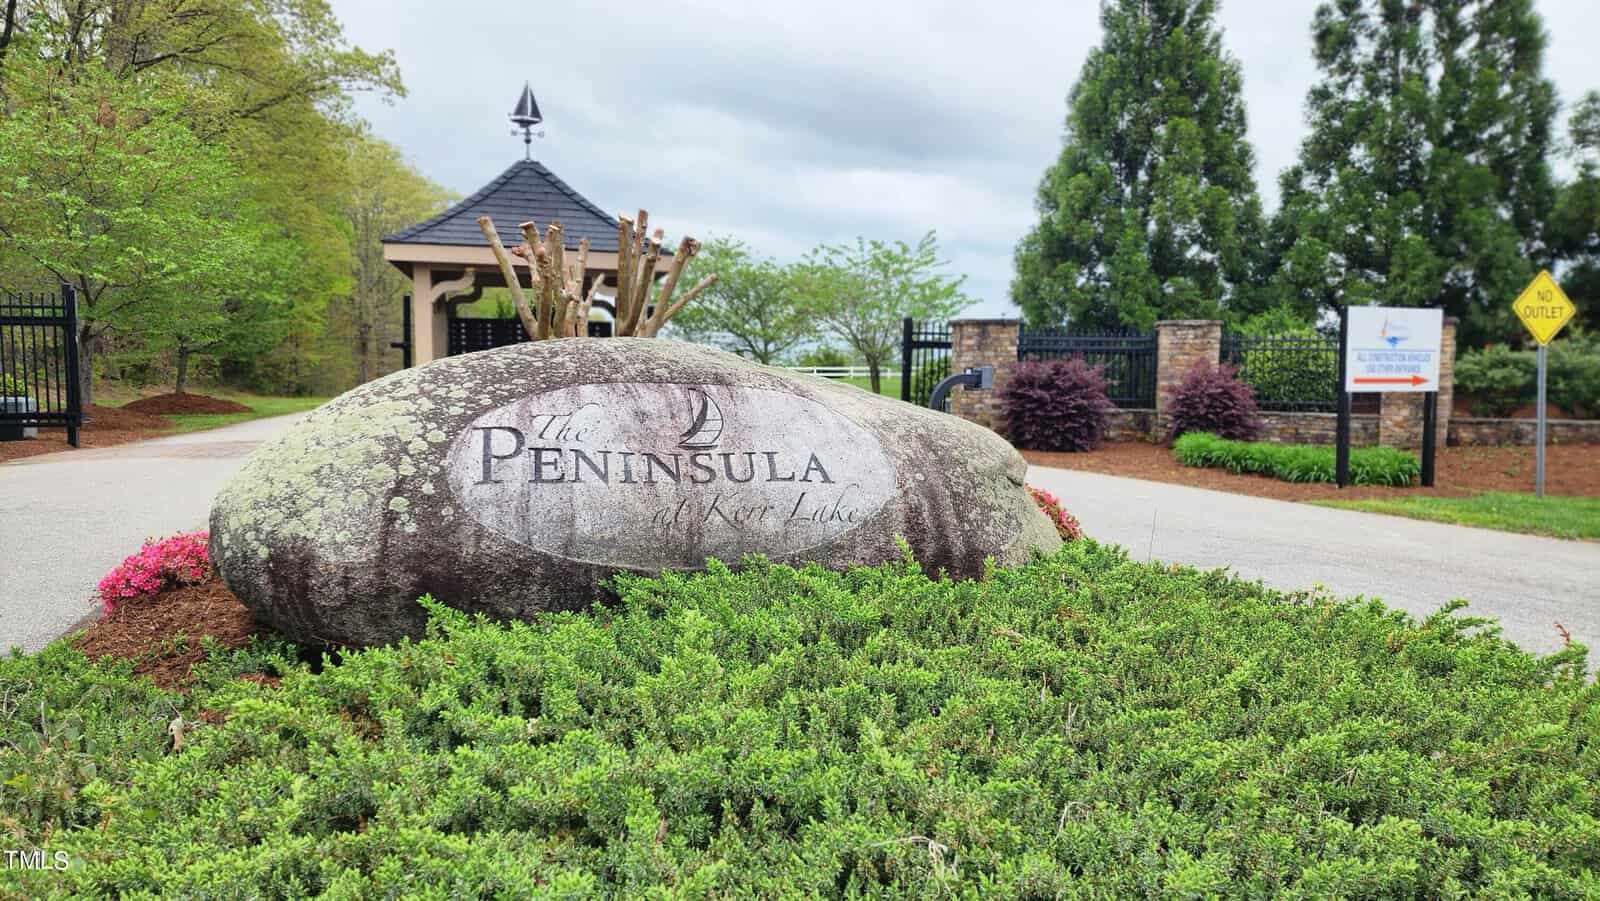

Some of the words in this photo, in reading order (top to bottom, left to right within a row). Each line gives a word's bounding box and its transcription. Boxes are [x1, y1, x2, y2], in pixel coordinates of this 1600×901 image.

[1523, 304, 1563, 319] OUTLET
[1537, 289, 1552, 303] NO
[531, 402, 599, 442] The
[472, 426, 835, 486] PENINSULA
[652, 496, 688, 527] at
[703, 492, 774, 531] Kerr
[784, 483, 859, 526] Lake
